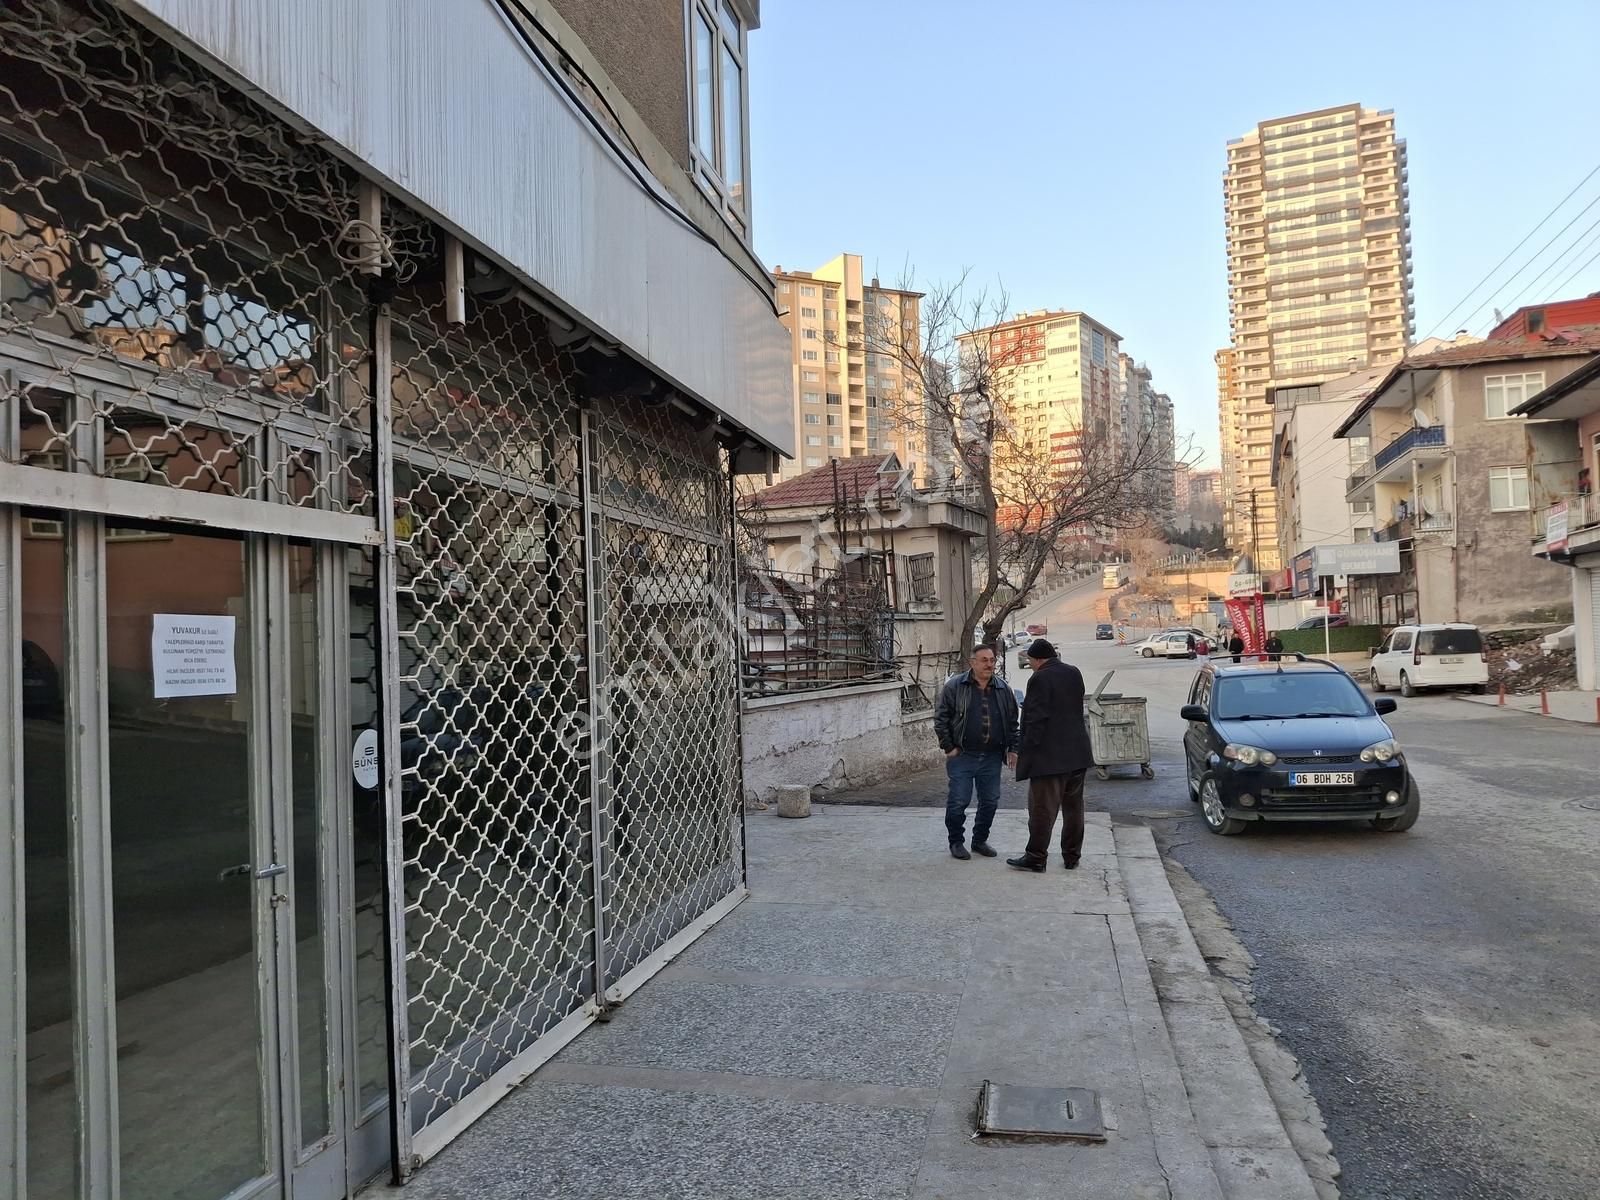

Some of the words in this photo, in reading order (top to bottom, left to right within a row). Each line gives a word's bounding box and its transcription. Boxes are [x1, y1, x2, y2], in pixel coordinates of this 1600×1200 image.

[1296, 774, 1308, 784] 06
[1314, 773, 1332, 784] BDH
[1336, 773, 1353, 784] 256
